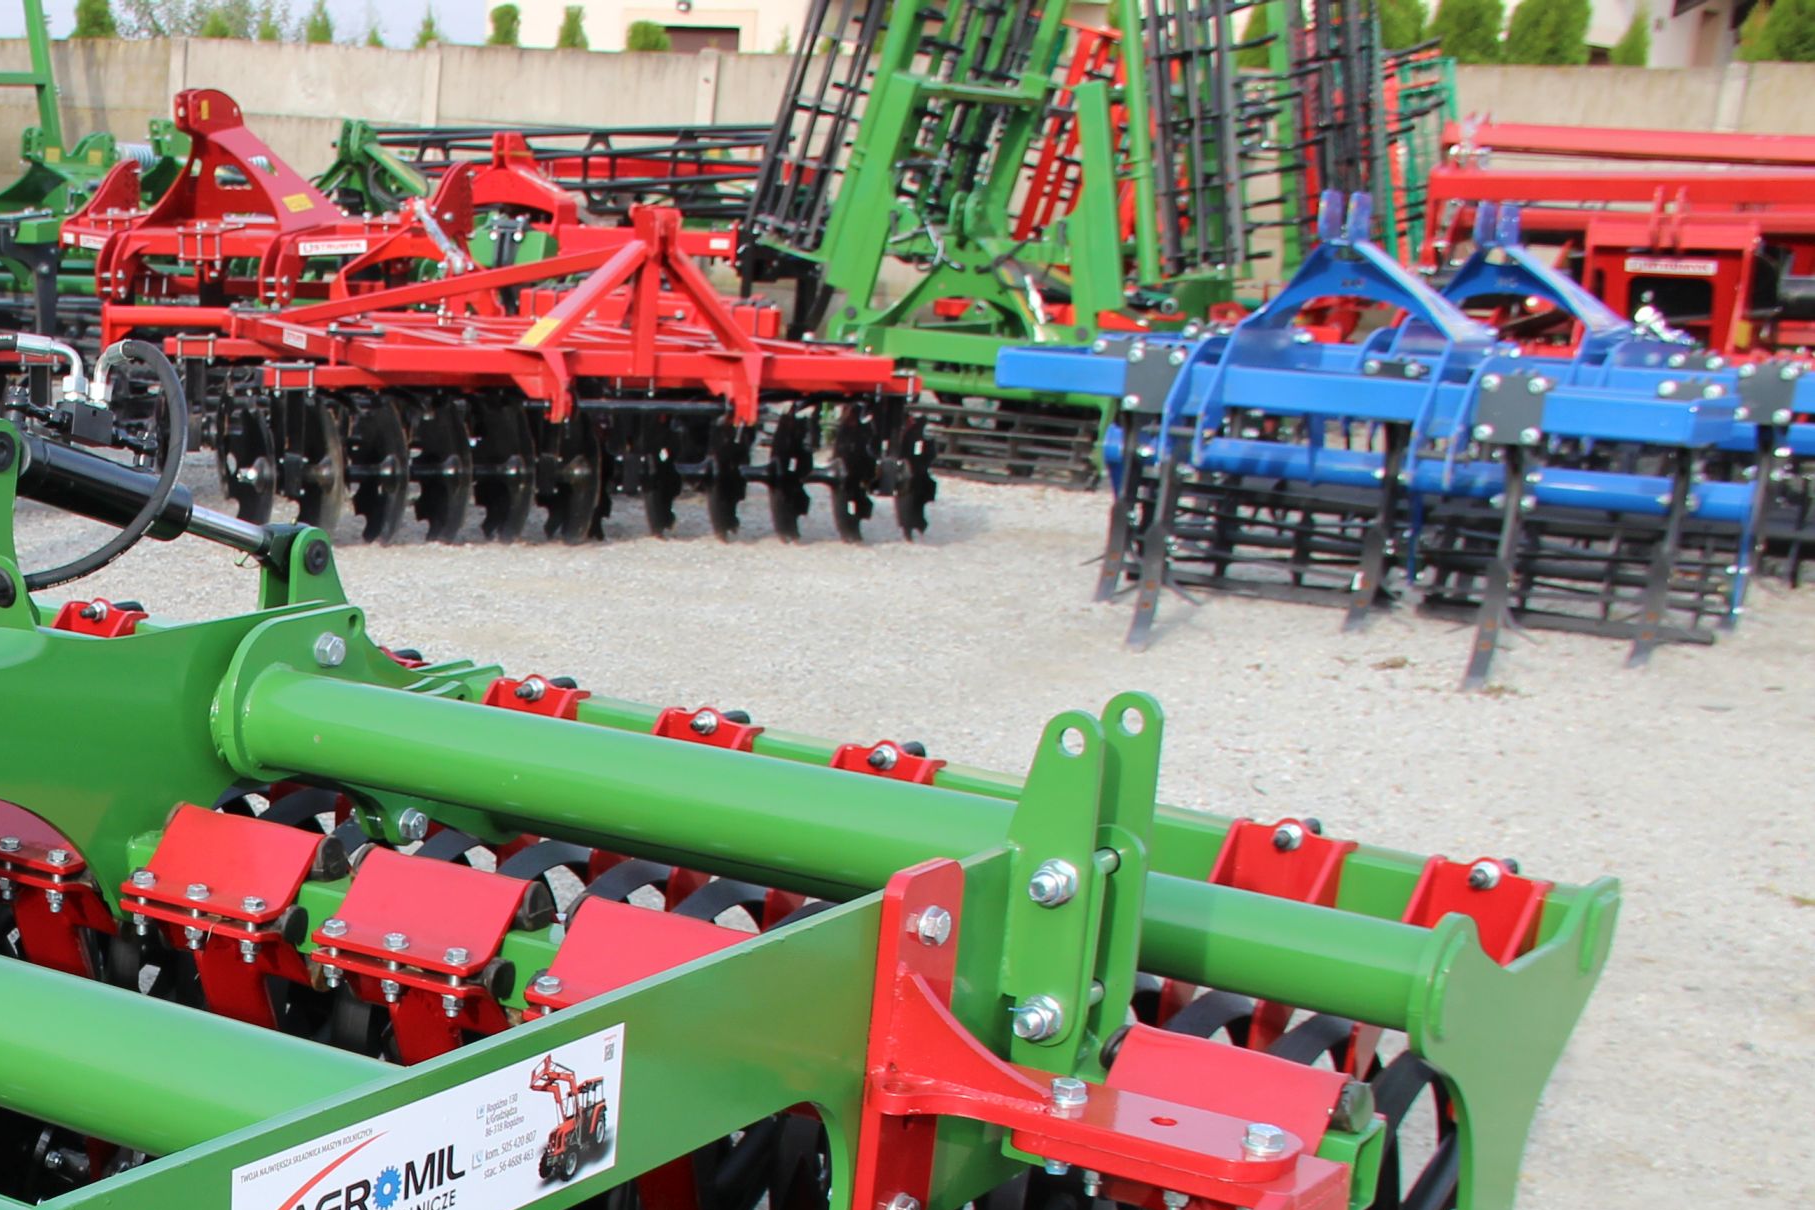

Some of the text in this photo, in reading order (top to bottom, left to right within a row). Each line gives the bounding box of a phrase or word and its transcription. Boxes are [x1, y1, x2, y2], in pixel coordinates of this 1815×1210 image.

[240, 1127, 373, 1184] TWOJA NAJWIĘKSZA SKŁADNICA MASZYN ROLNICZYCH
